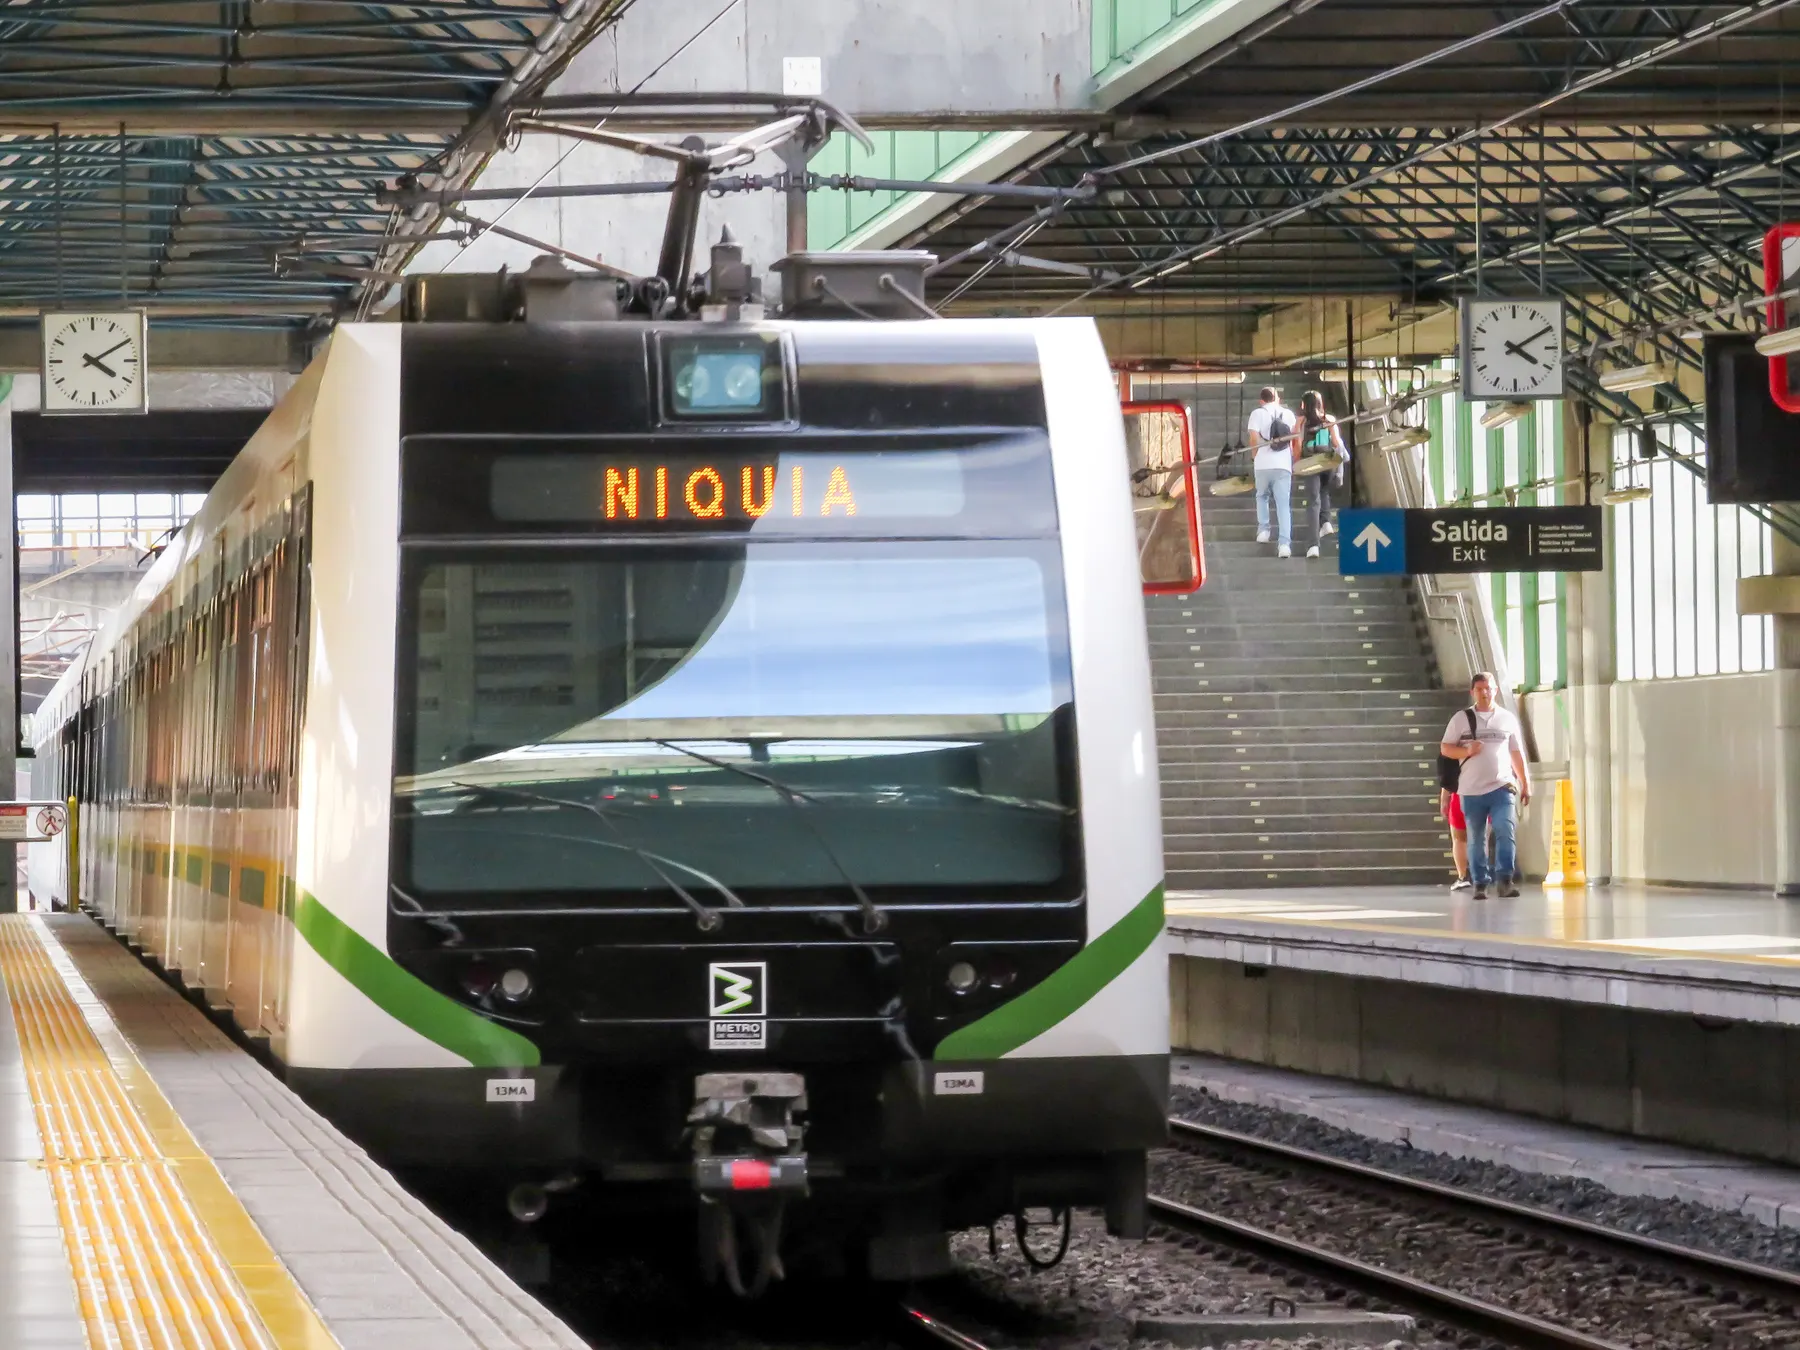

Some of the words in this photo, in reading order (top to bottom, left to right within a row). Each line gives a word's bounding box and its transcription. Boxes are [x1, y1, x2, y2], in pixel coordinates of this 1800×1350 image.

[605, 466, 856, 519] NIQUIA
[1431, 519, 1508, 543] Salida
[1452, 546, 1486, 562] Exit
[716, 1023, 760, 1033] METRO
[943, 1079, 976, 1089] 13MA
[495, 1086, 528, 1096] 13MA
